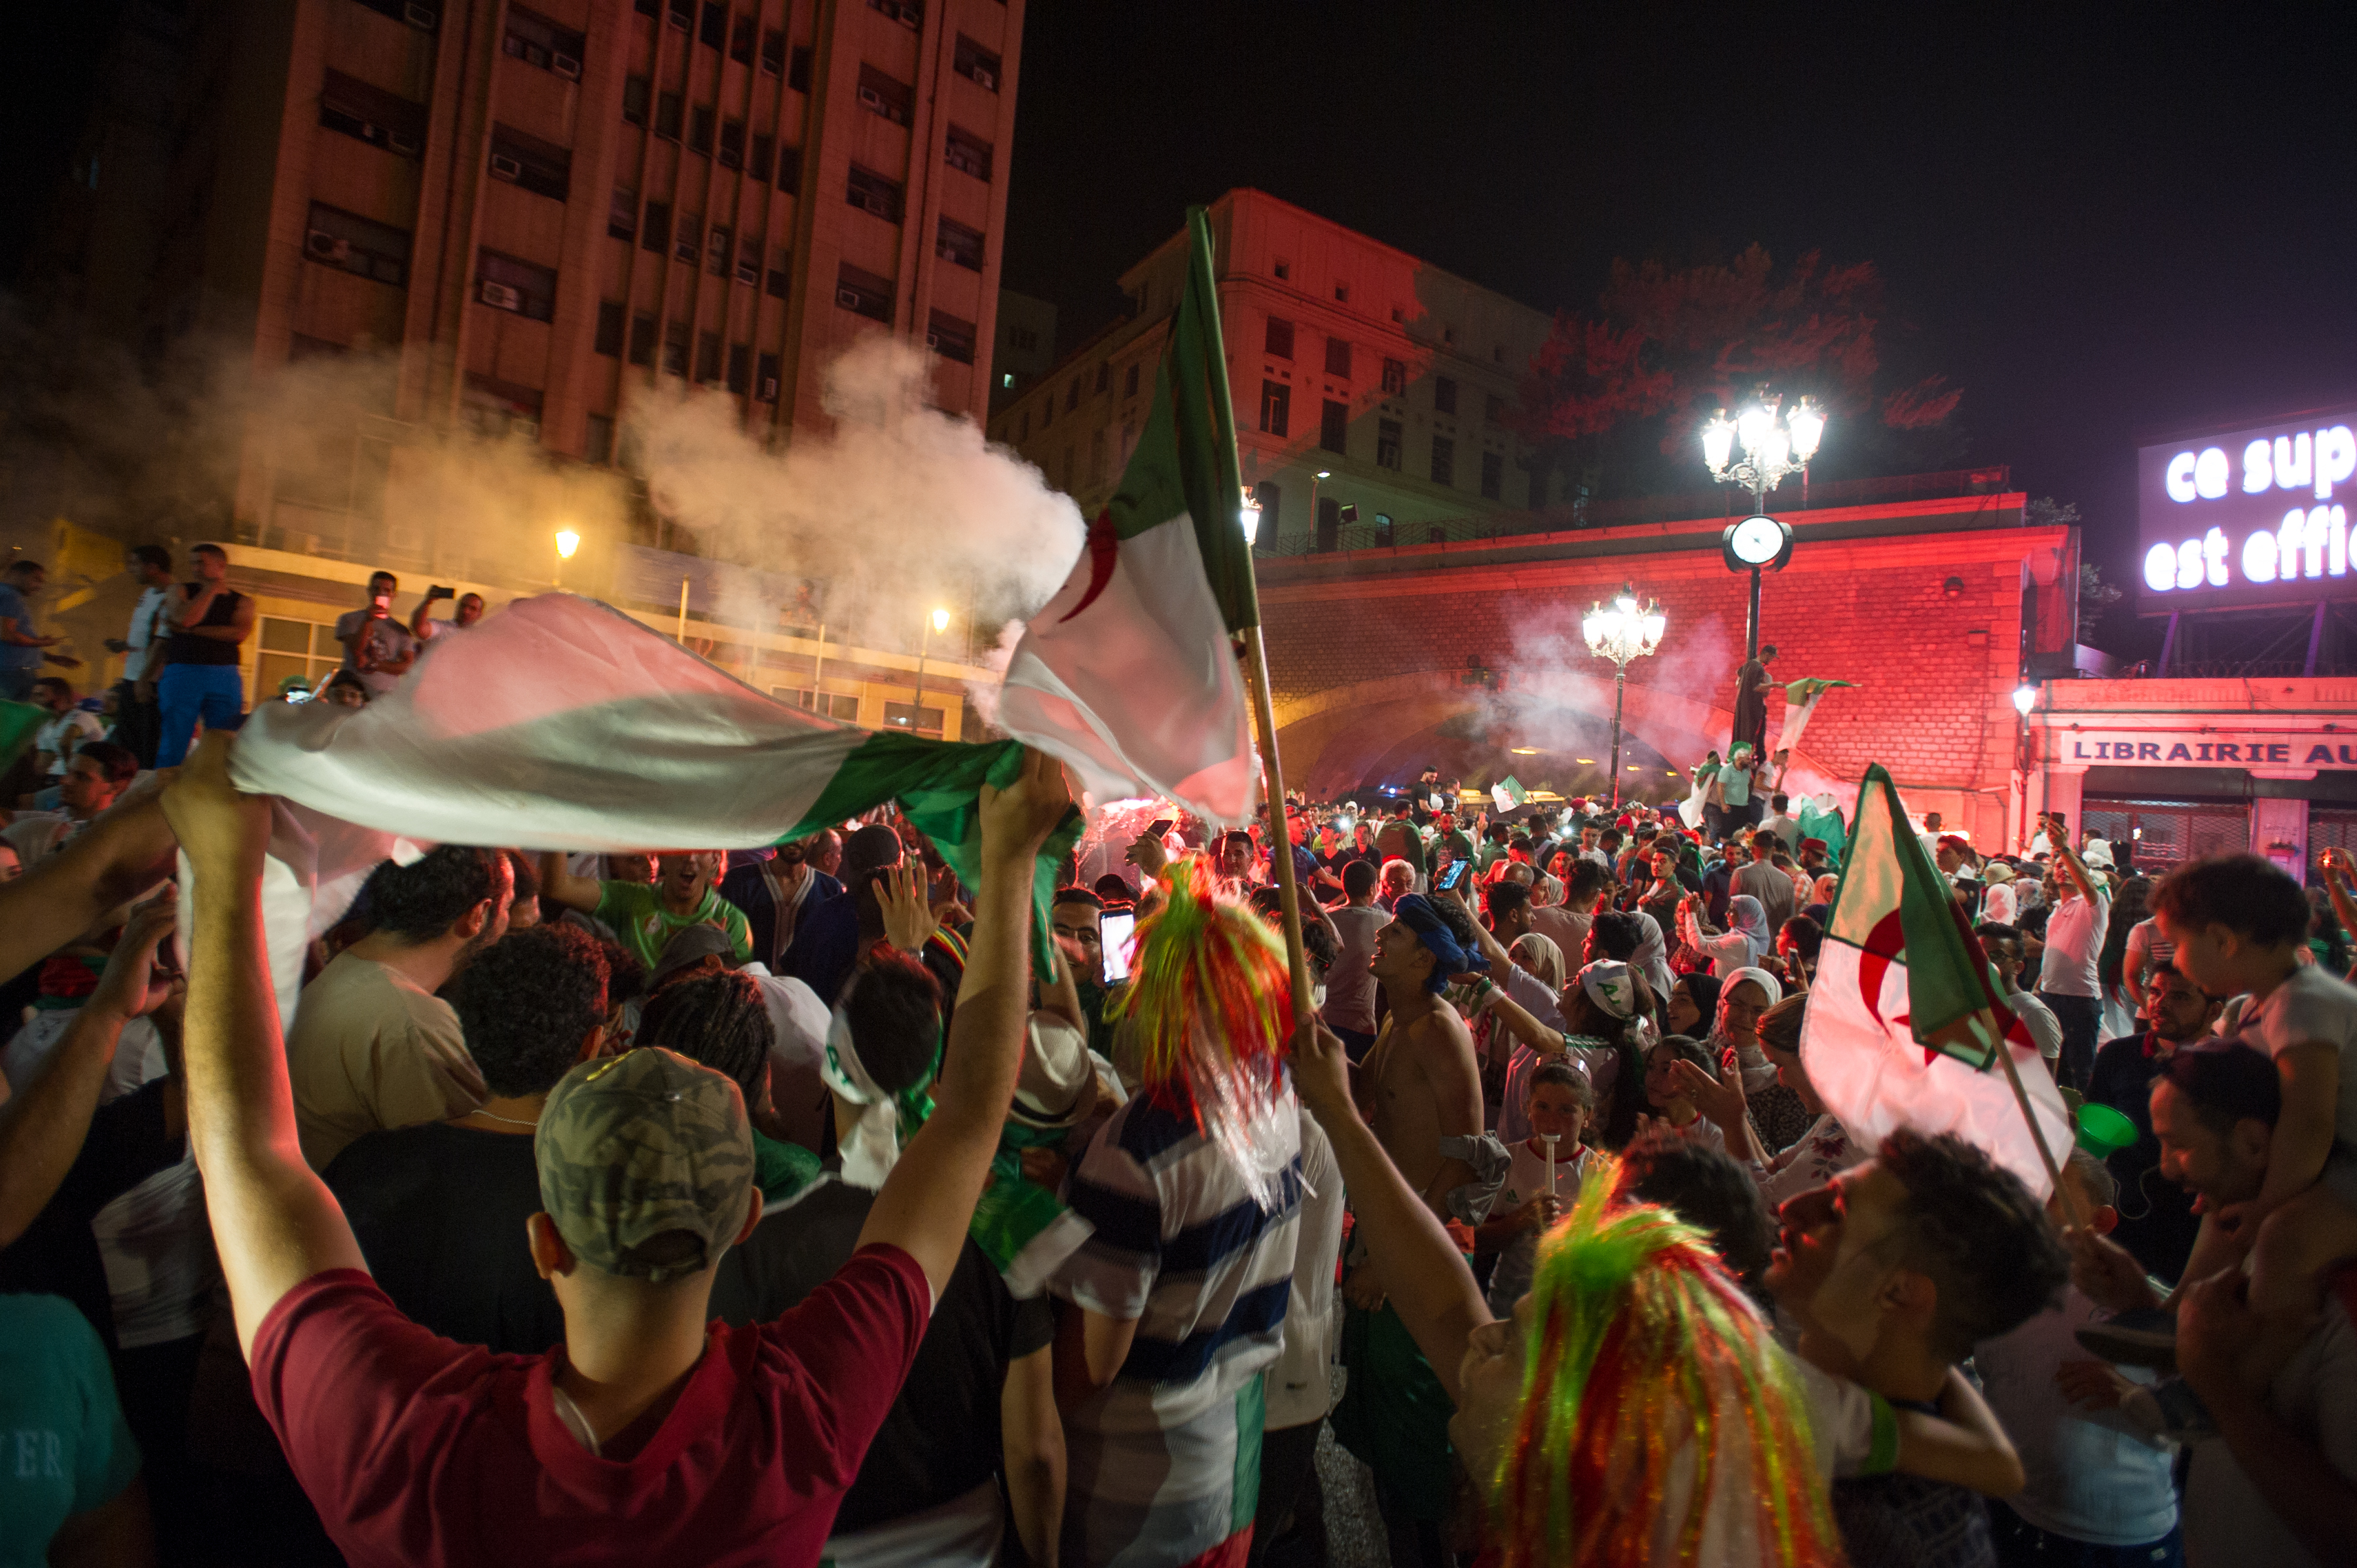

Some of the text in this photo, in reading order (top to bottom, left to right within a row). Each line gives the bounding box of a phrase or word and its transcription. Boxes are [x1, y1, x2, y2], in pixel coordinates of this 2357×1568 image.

[2242, 424, 2357, 500] sup
[2144, 503, 2357, 591] est effi
[2074, 741, 2357, 765] LIBRAIRIE AU
[0, 1430, 64, 1478] ER
